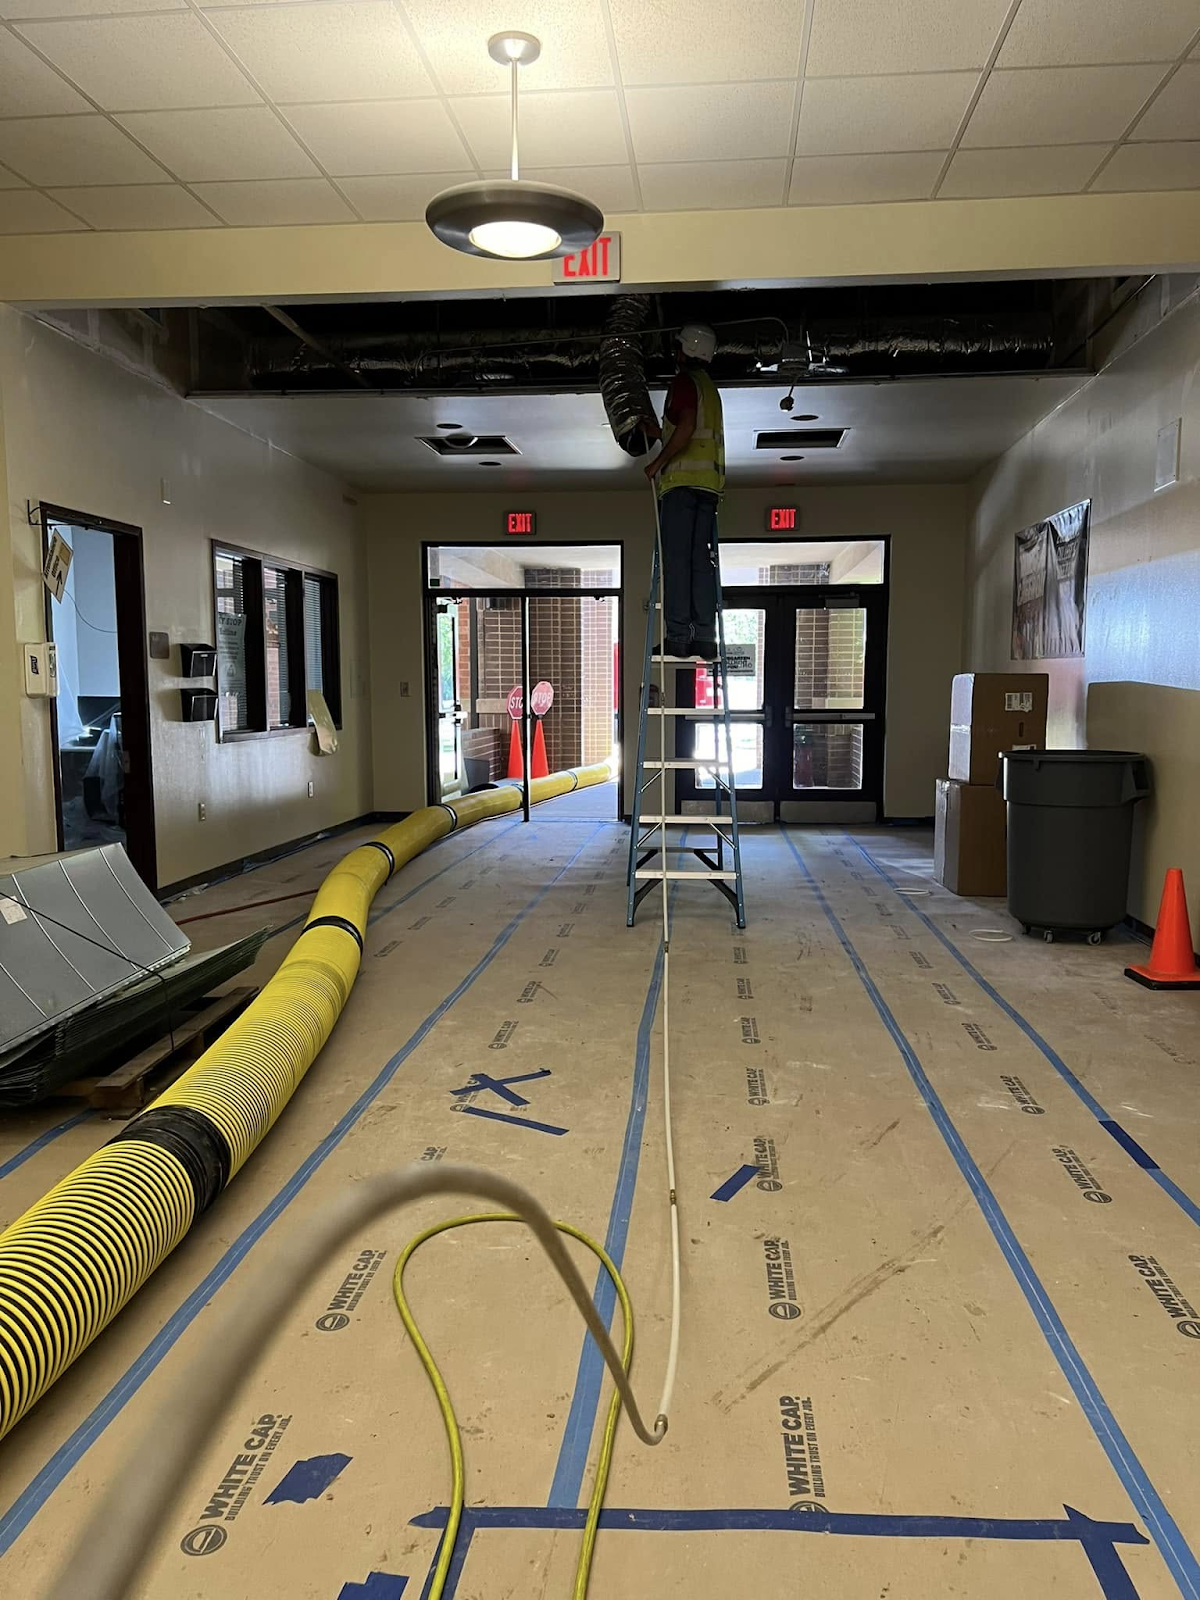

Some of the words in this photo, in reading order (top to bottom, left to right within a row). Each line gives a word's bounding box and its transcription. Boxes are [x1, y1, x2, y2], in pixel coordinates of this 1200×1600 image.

[564, 237, 611, 276] EXIT
[508, 513, 532, 533] EXIT
[771, 509, 796, 529] EXIT
[1063, 1164, 1093, 1189] WHITE
[327, 1273, 365, 1311] WHITE
[766, 1262, 786, 1300] WHITE
[1145, 1279, 1187, 1318] WHITE
[803, 1412, 816, 1431] EVERY
[806, 1432, 818, 1441] ON
[783, 1433, 811, 1496] WHITE
[808, 1443, 820, 1463] TRUST
[200, 1454, 258, 1520] WHITE
[224, 1486, 253, 1521] BUILDING
[245, 1463, 267, 1485] TRUST
[258, 1452, 272, 1462] ON
[265, 1431, 284, 1451] EVERY
[811, 1464, 826, 1498] BUILDING
